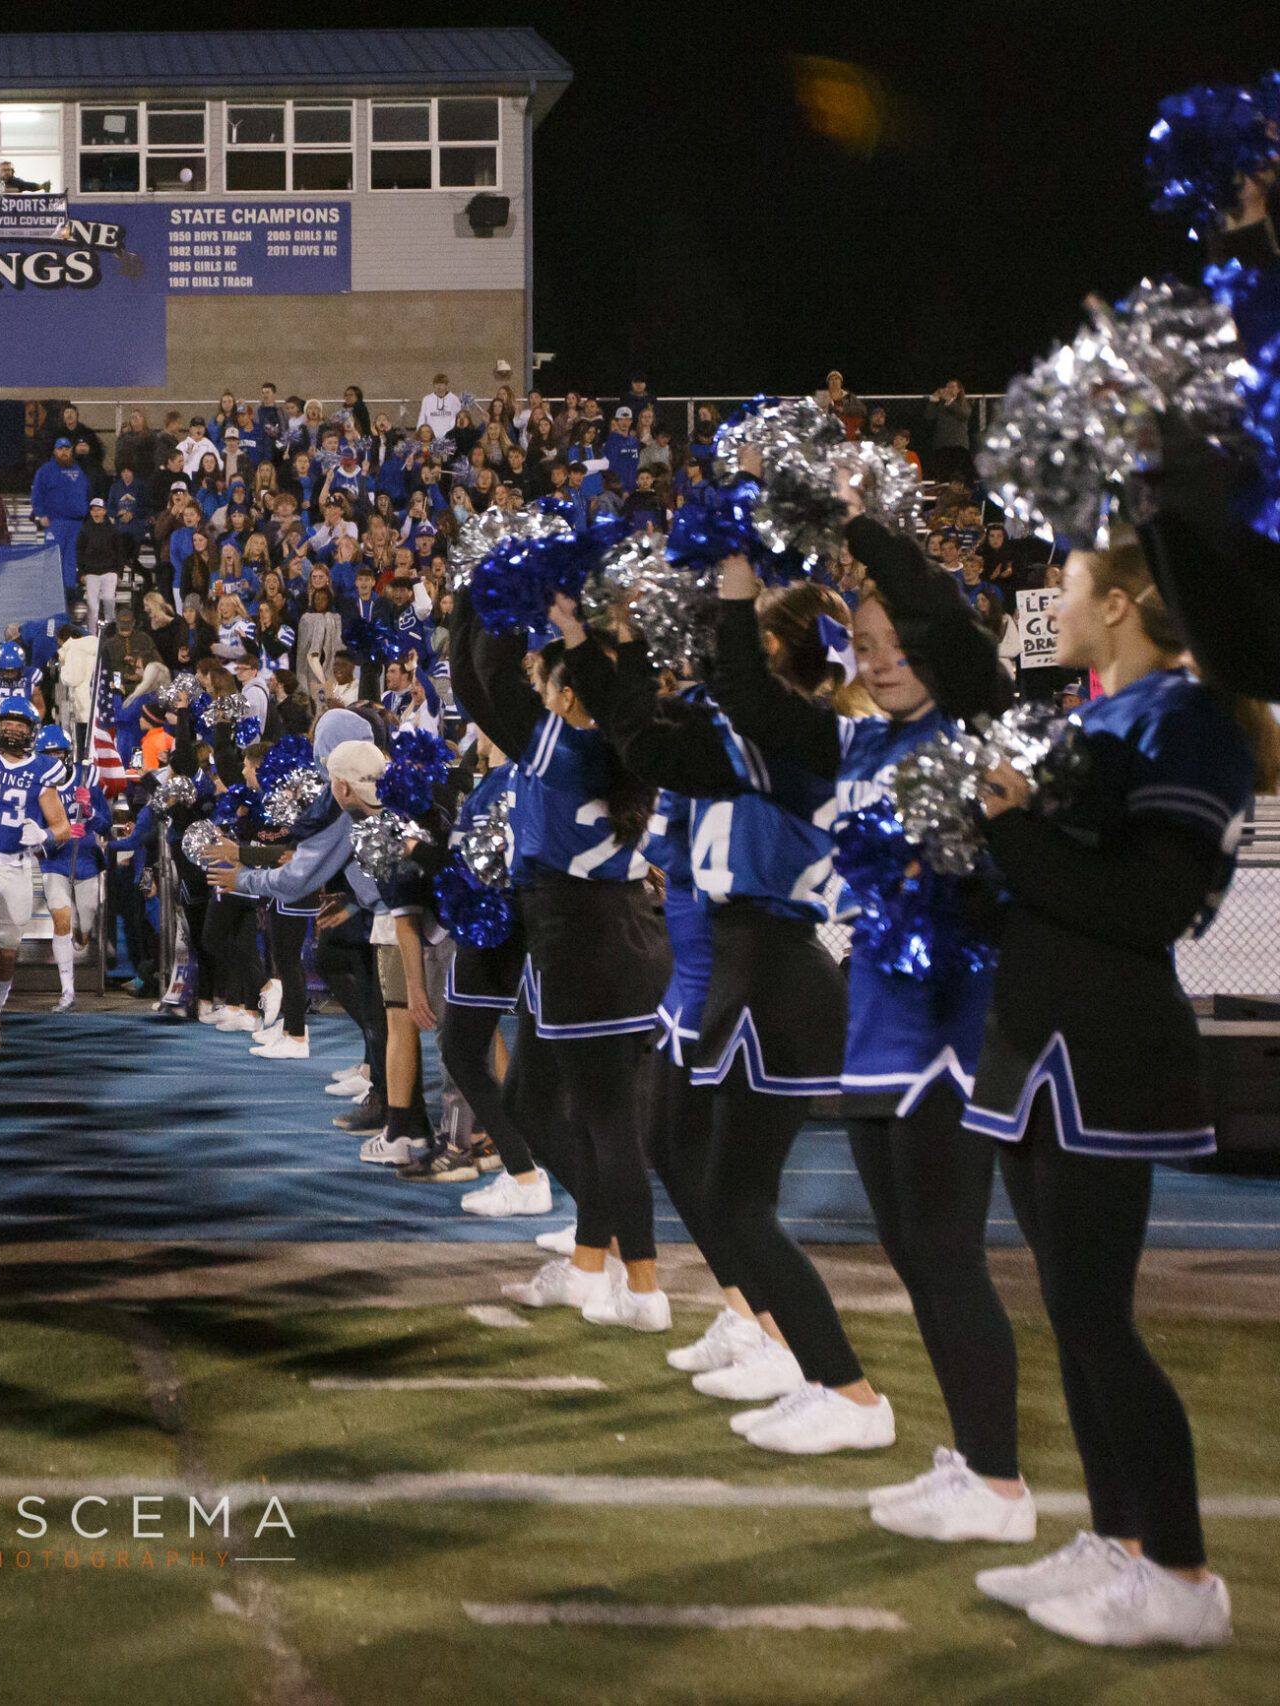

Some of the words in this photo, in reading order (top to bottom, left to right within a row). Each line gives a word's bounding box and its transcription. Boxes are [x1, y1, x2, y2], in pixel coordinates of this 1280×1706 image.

[20, 216, 65, 226] COVERED
[170, 209, 226, 224] STATE
[231, 208, 340, 224] CHAMPIONS
[168, 231, 191, 242] 1950
[194, 231, 219, 242] BOYS
[222, 231, 252, 242] TRACK
[267, 231, 291, 241] 2005
[294, 231, 321, 241] GIRLS
[193, 246, 221, 257] GIRLS
[267, 246, 289, 256] 2011
[292, 246, 320, 256] BOYS
[194, 261, 221, 272] GIRLS
[168, 277, 190, 287] 1991
[192, 277, 220, 287] GIRLS
[222, 277, 253, 287] TRACK
